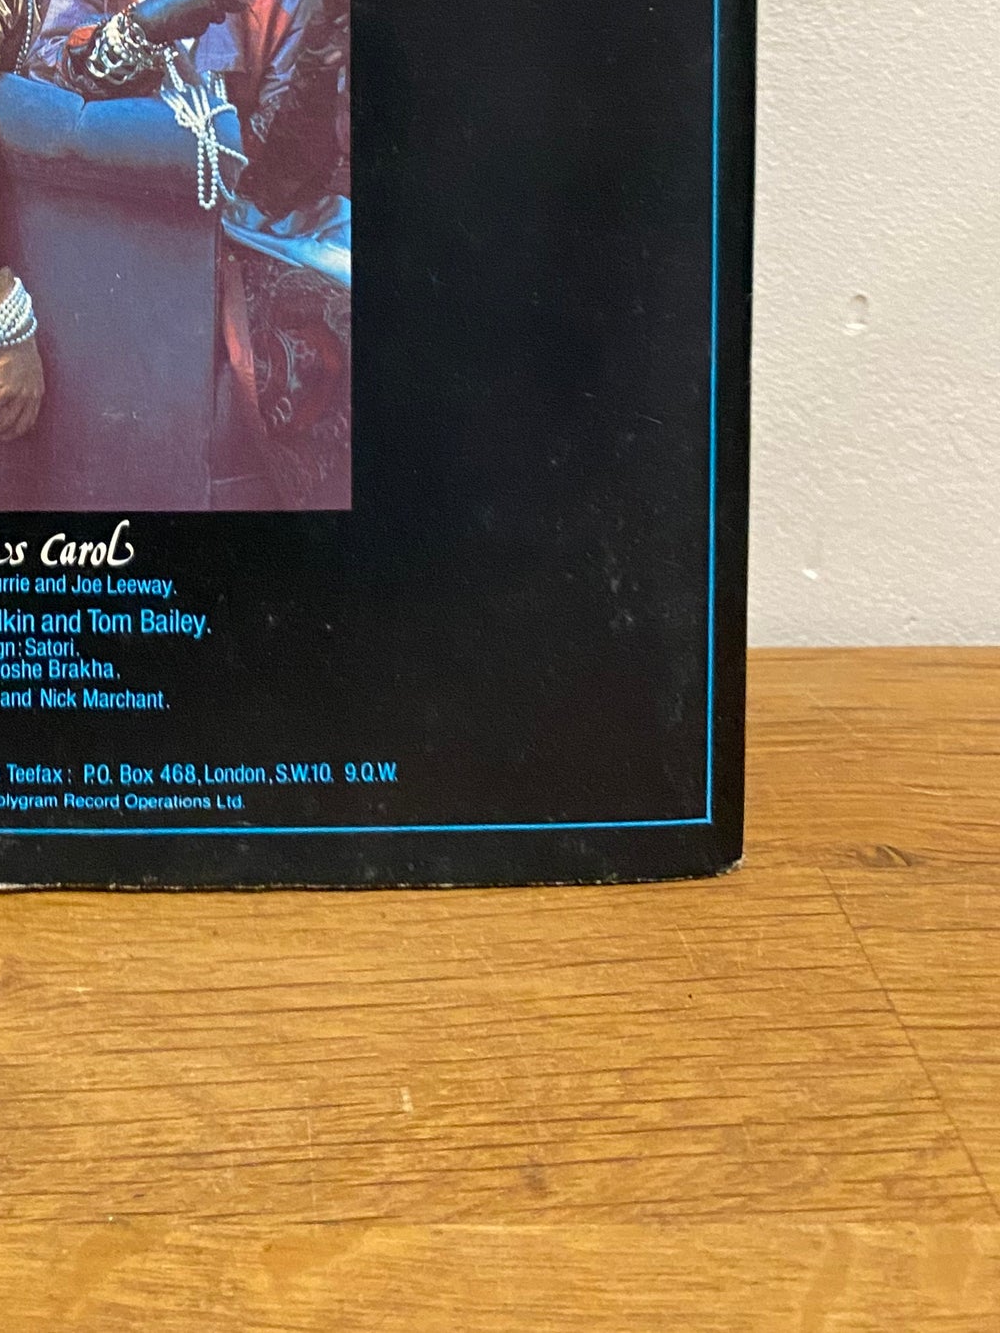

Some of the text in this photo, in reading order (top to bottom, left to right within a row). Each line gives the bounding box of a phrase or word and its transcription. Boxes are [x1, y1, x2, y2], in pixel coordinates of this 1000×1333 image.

[40, 519, 135, 567] Carol
[34, 573, 67, 594] and
[70, 574, 103, 595] Joe
[106, 574, 178, 599] Leeway.
[40, 608, 82, 634] and
[86, 608, 132, 634] Tom
[140, 608, 212, 640] Bailey.
[24, 636, 81, 657] Satori.
[48, 658, 121, 680] Brakha.
[0, 687, 32, 708] and
[39, 687, 77, 709] Nick
[82, 687, 171, 710] Marchant.
[83, 762, 114, 785] P.O.
[119, 762, 154, 786] Box
[63, 792, 120, 810] Record
[124, 792, 212, 811] Operations
[216, 794, 247, 810] Ltd.
